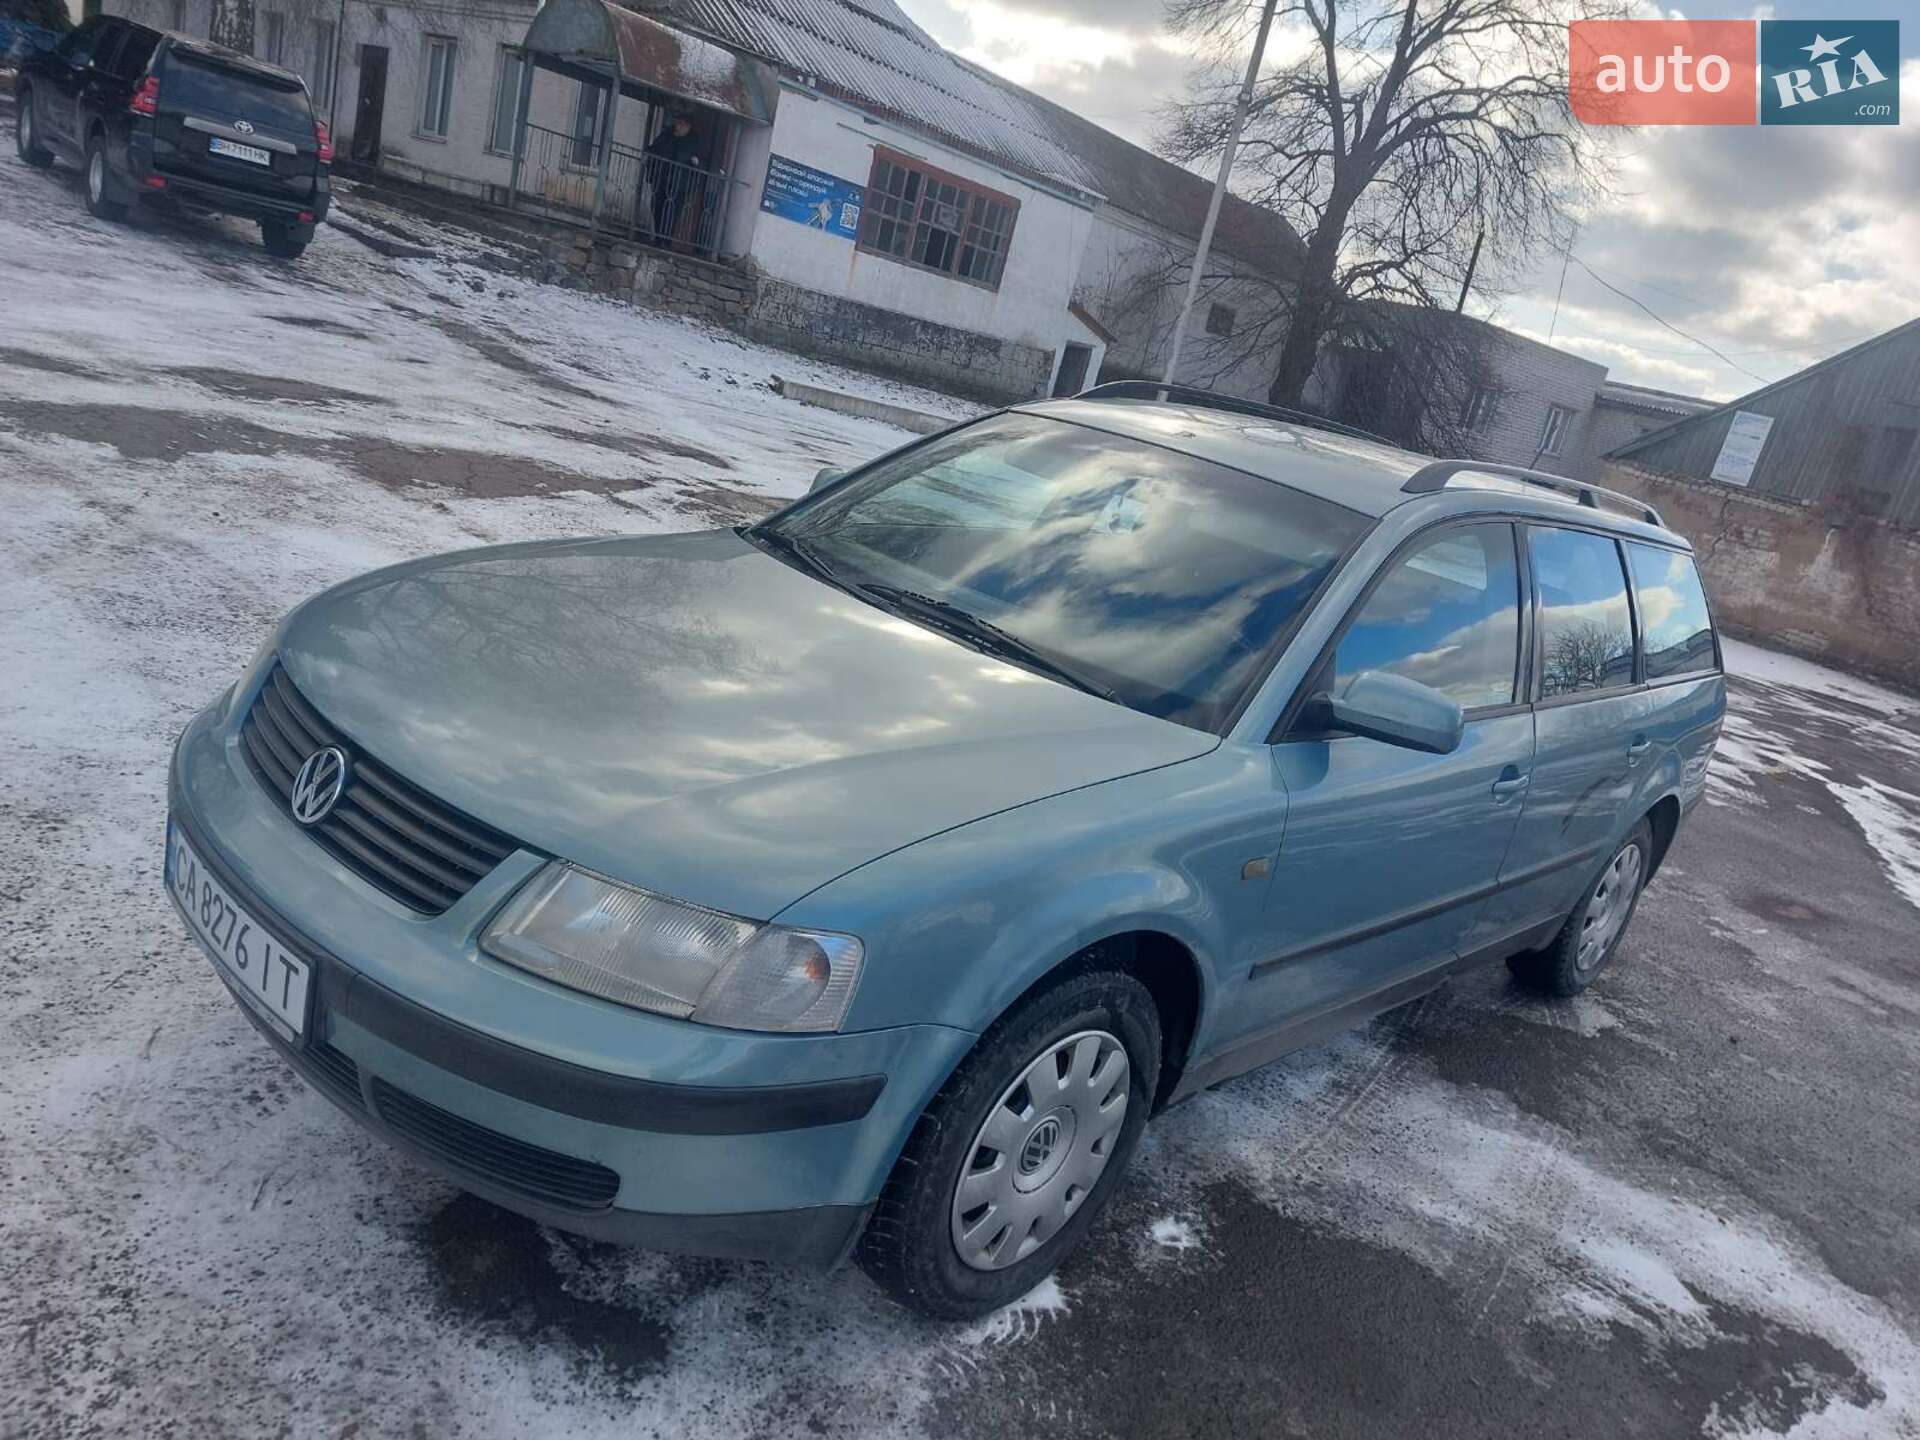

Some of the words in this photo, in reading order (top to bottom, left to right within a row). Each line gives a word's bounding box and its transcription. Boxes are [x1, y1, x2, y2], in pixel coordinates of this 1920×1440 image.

[175, 846, 197, 912] CA
[200, 880, 250, 970] 8276
[262, 943, 299, 1010] IT
